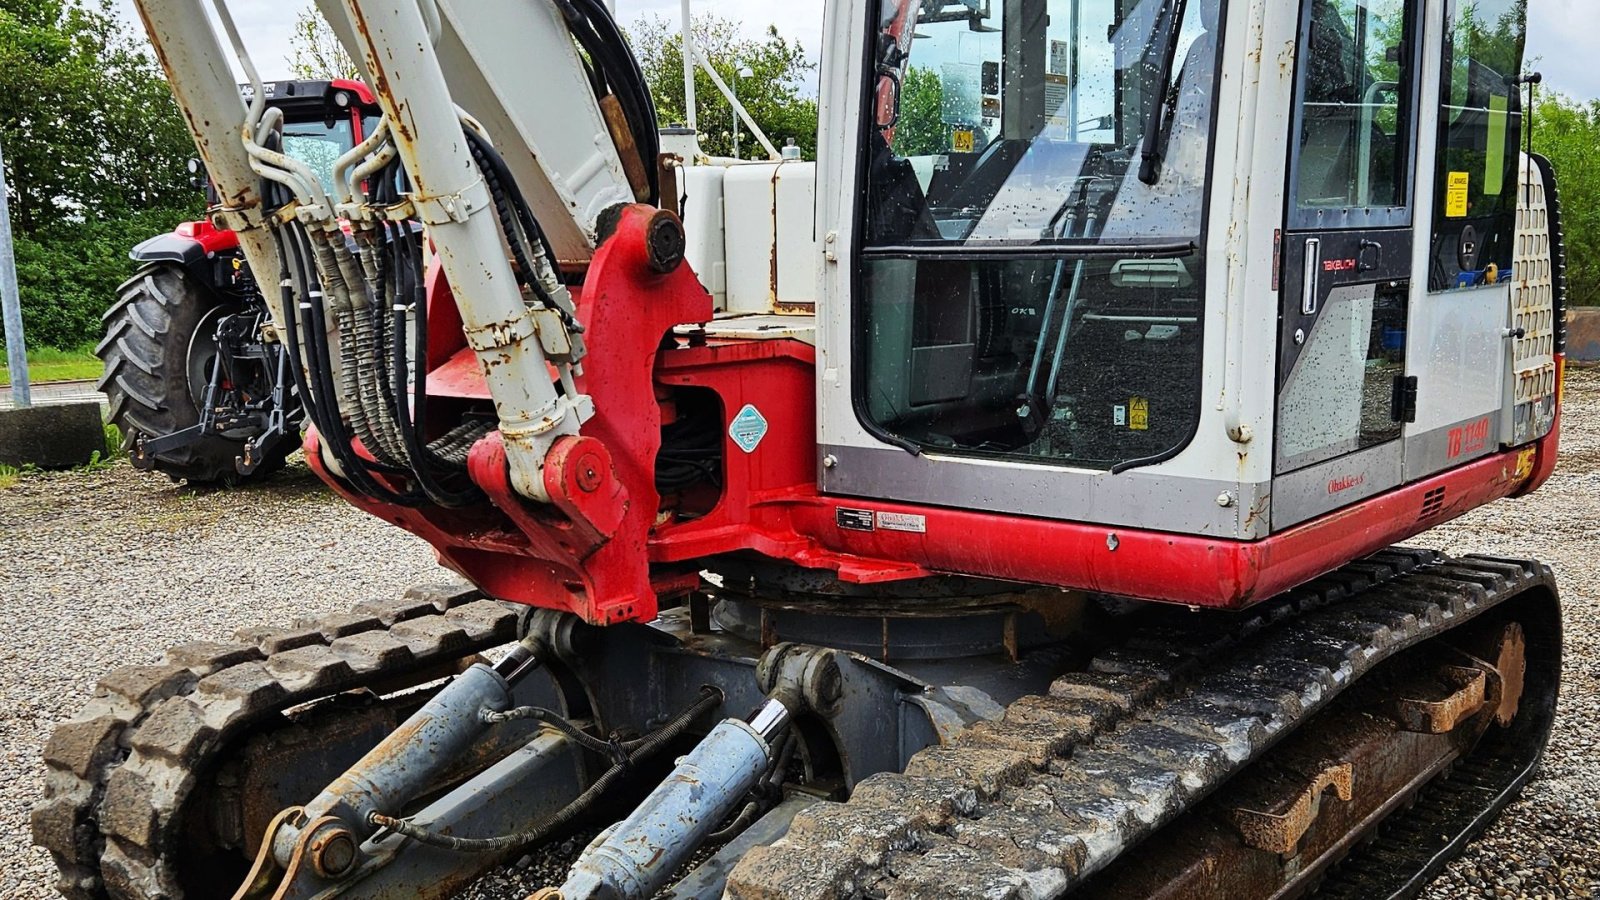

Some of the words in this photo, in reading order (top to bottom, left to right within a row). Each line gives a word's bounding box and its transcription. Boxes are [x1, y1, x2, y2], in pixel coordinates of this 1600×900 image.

[1323, 259, 1356, 271] TAKEUCHI
[1447, 428, 1461, 458] TB
[1465, 417, 1488, 442] 1140
